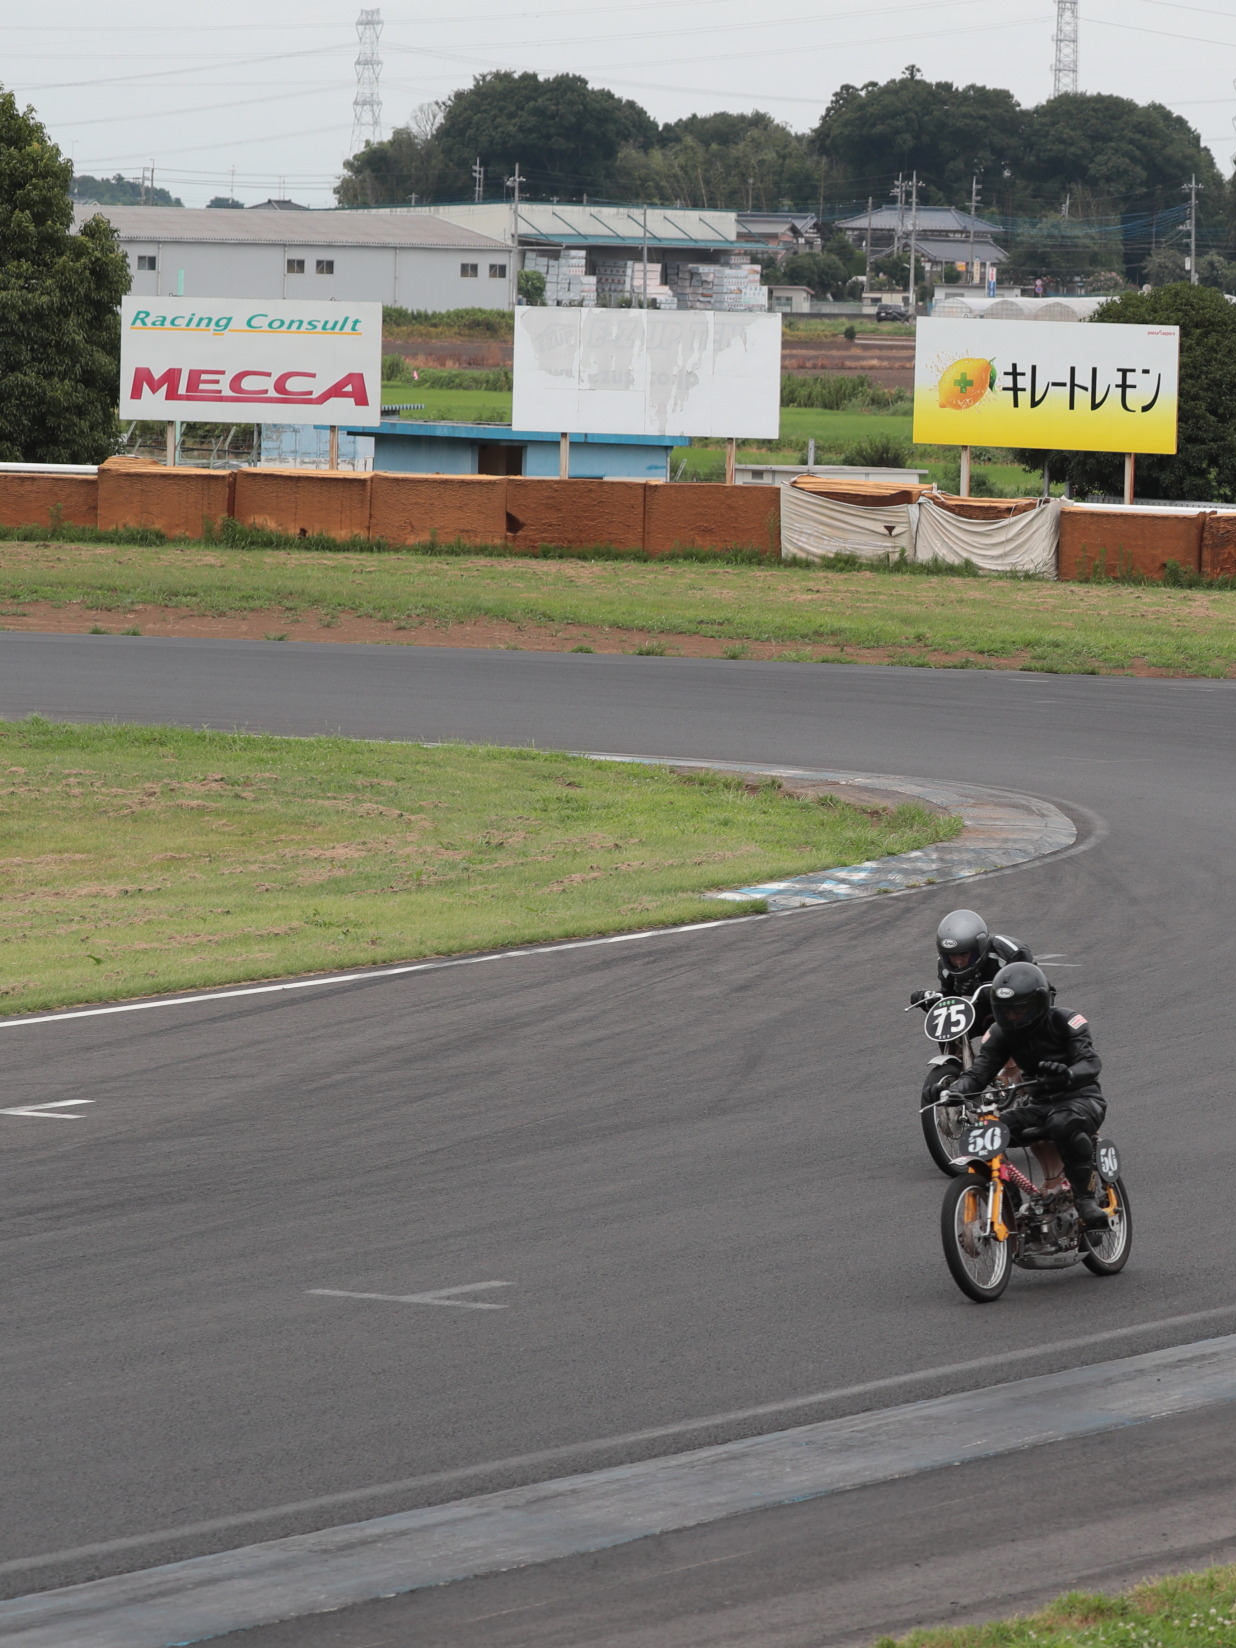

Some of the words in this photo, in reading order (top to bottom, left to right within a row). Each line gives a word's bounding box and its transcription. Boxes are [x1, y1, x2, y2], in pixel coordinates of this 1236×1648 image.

[130, 310, 233, 332] Racing
[245, 313, 363, 332] Consult
[130, 367, 370, 407] MECCA
[1002, 362, 1162, 413] キレートレモン
[932, 1003, 967, 1037] 75
